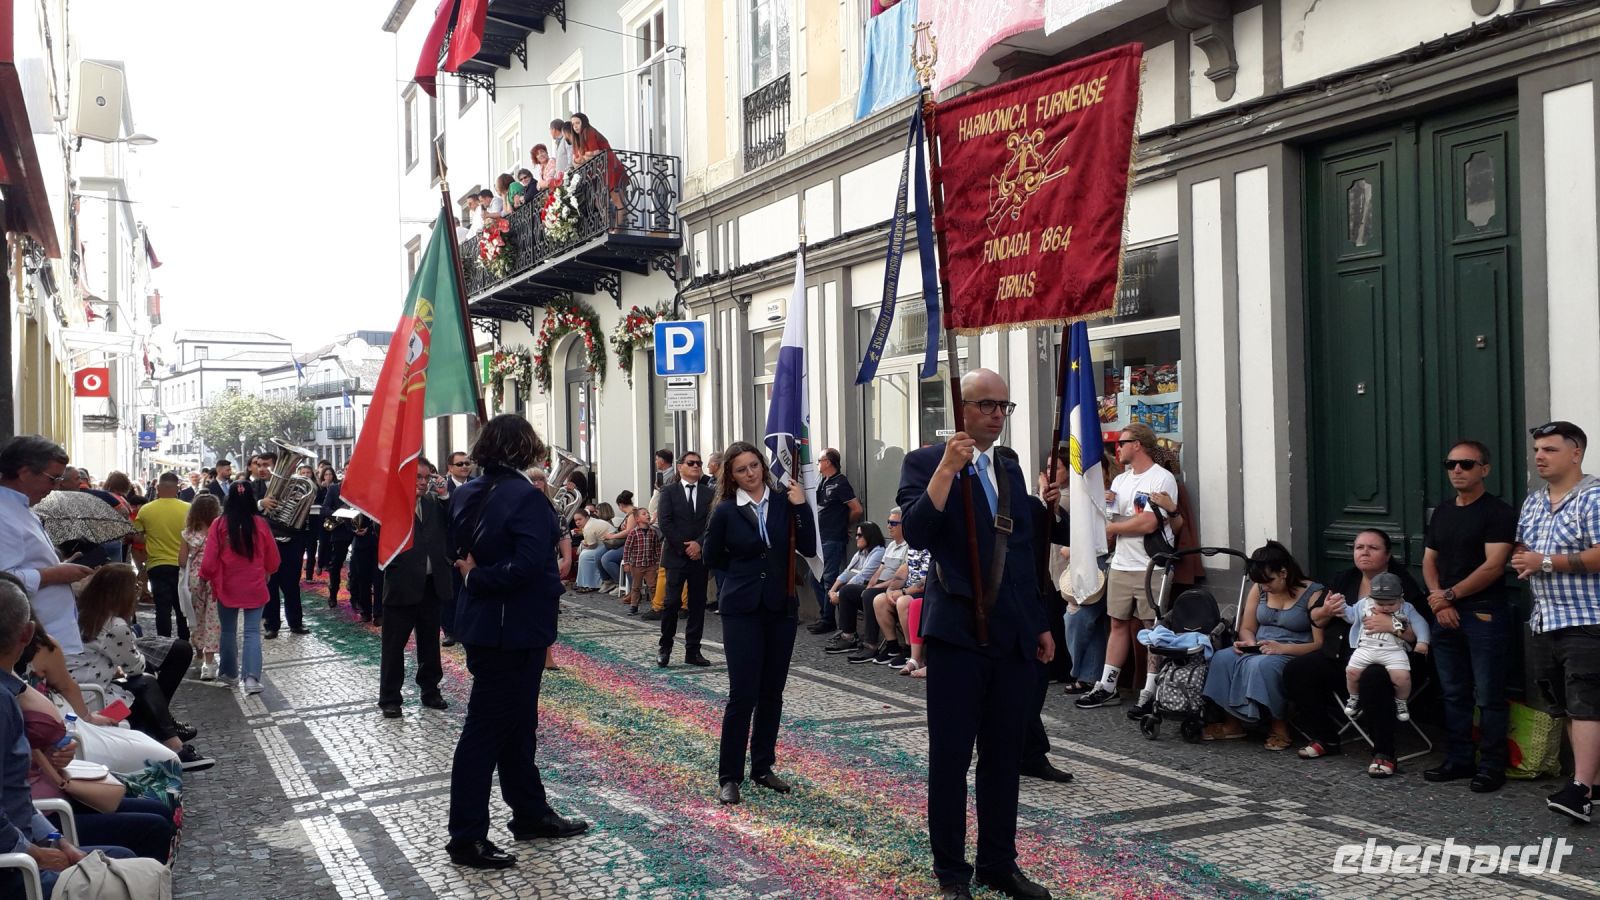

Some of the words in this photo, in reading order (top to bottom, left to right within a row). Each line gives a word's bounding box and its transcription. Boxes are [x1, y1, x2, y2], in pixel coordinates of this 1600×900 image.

[1036, 75, 1108, 122] FURNENSE
[984, 232, 1031, 263] FUNDADA
[1039, 225, 1072, 252] 1864
[996, 270, 1036, 301] FURNAS
[665, 326, 695, 371] P
[871, 314, 891, 349] FURNENSE
